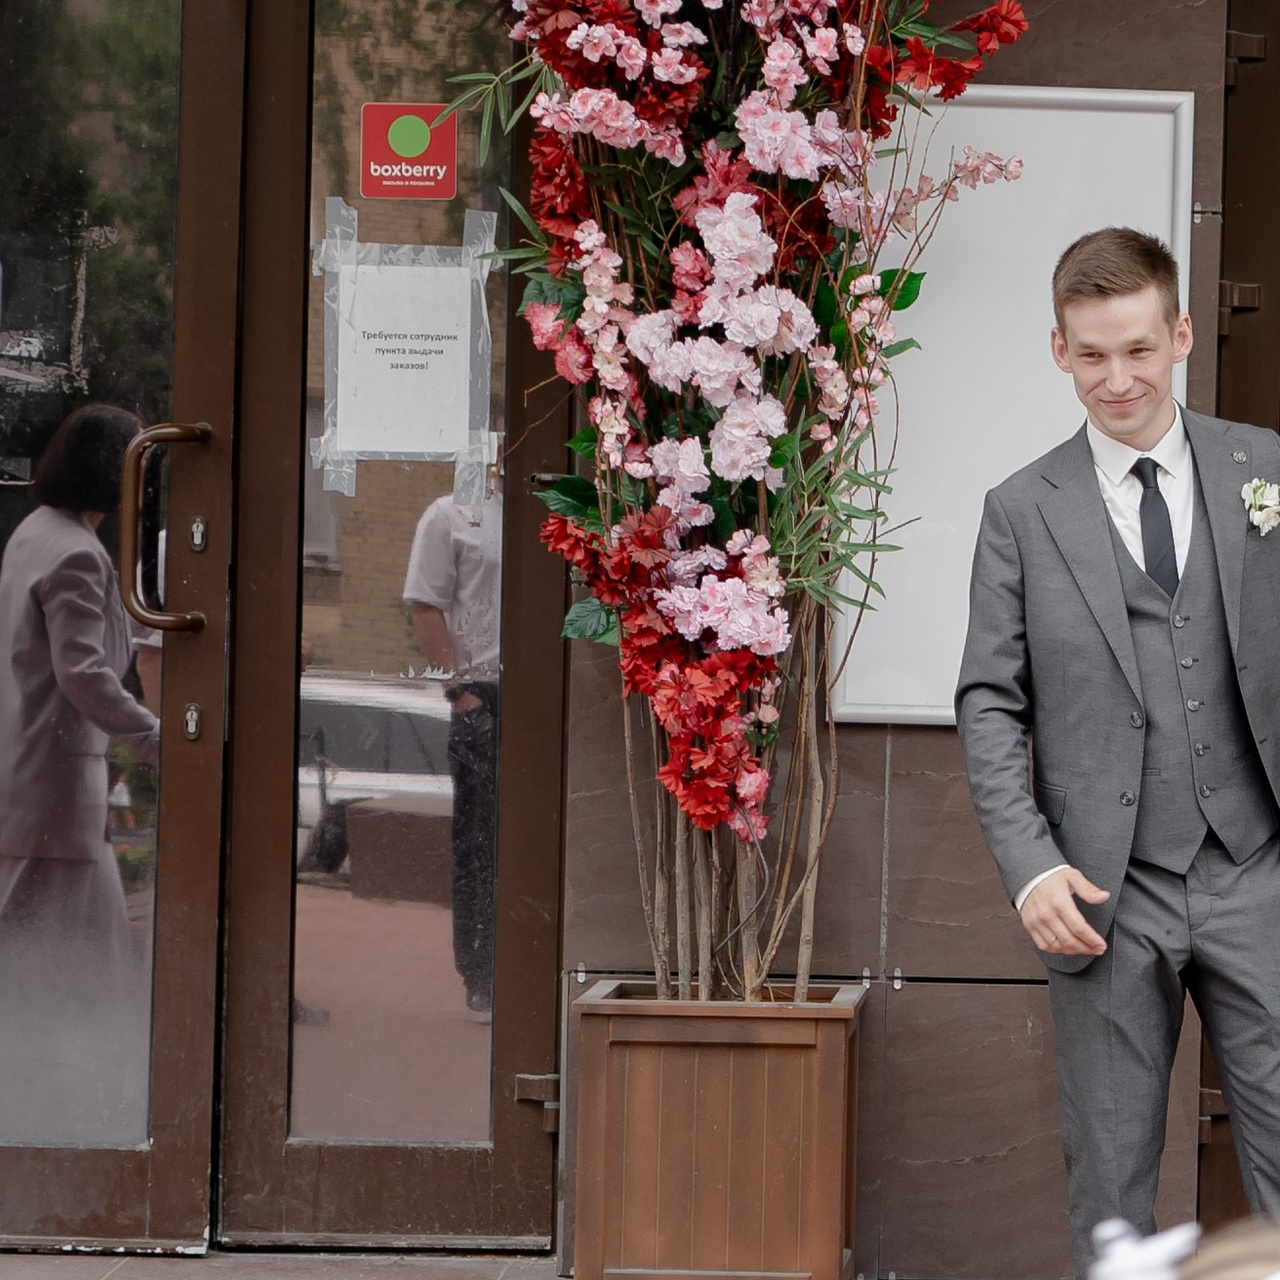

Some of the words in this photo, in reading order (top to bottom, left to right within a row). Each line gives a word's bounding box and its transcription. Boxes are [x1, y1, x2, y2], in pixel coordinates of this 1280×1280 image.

[370, 161, 447, 180] boxberry
[361, 330, 408, 341] Требуется
[410, 333, 458, 341] сотрудник
[375, 348, 406, 356] пункта
[408, 348, 444, 356] выдачи
[390, 361, 429, 370] заказов!
